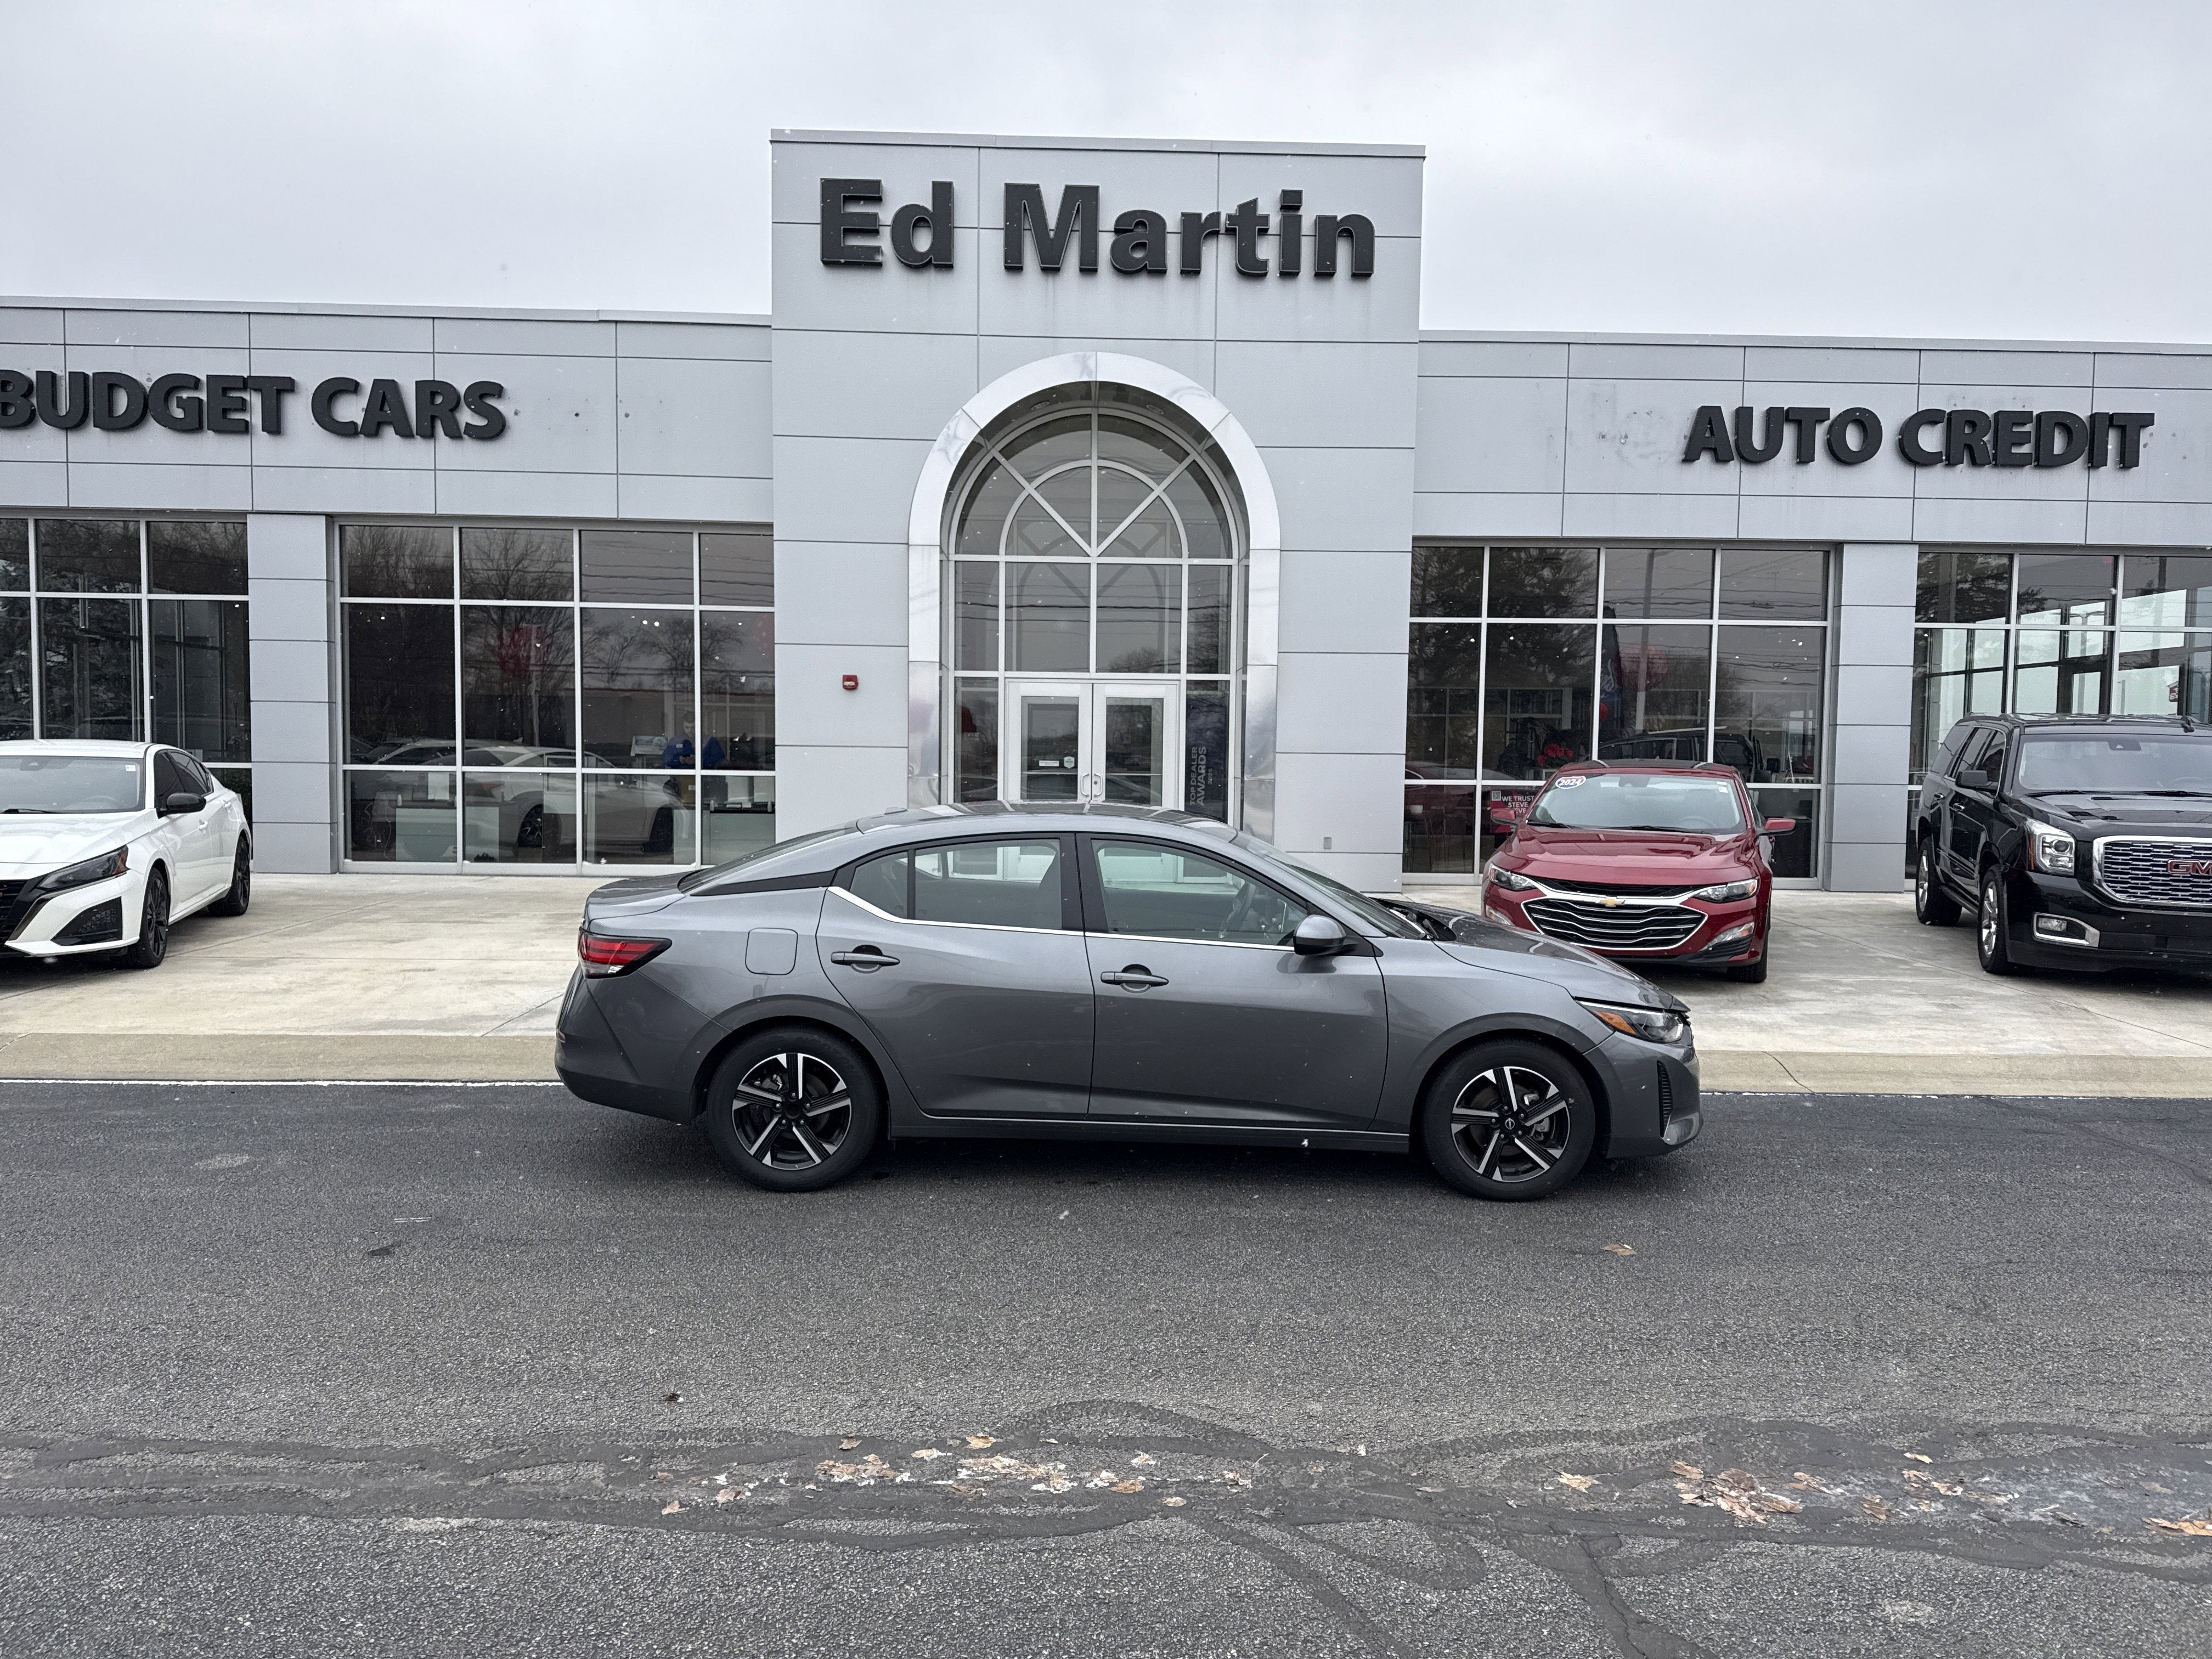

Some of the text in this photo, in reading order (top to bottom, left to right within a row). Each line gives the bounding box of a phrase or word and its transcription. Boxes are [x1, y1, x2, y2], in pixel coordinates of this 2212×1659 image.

[820, 178, 1375, 278] Ed Martin
[0, 369, 506, 439] BUDGET CARS
[1681, 405, 2154, 468] AUTO CREDIT
[1197, 746, 1206, 806] AWARDS
